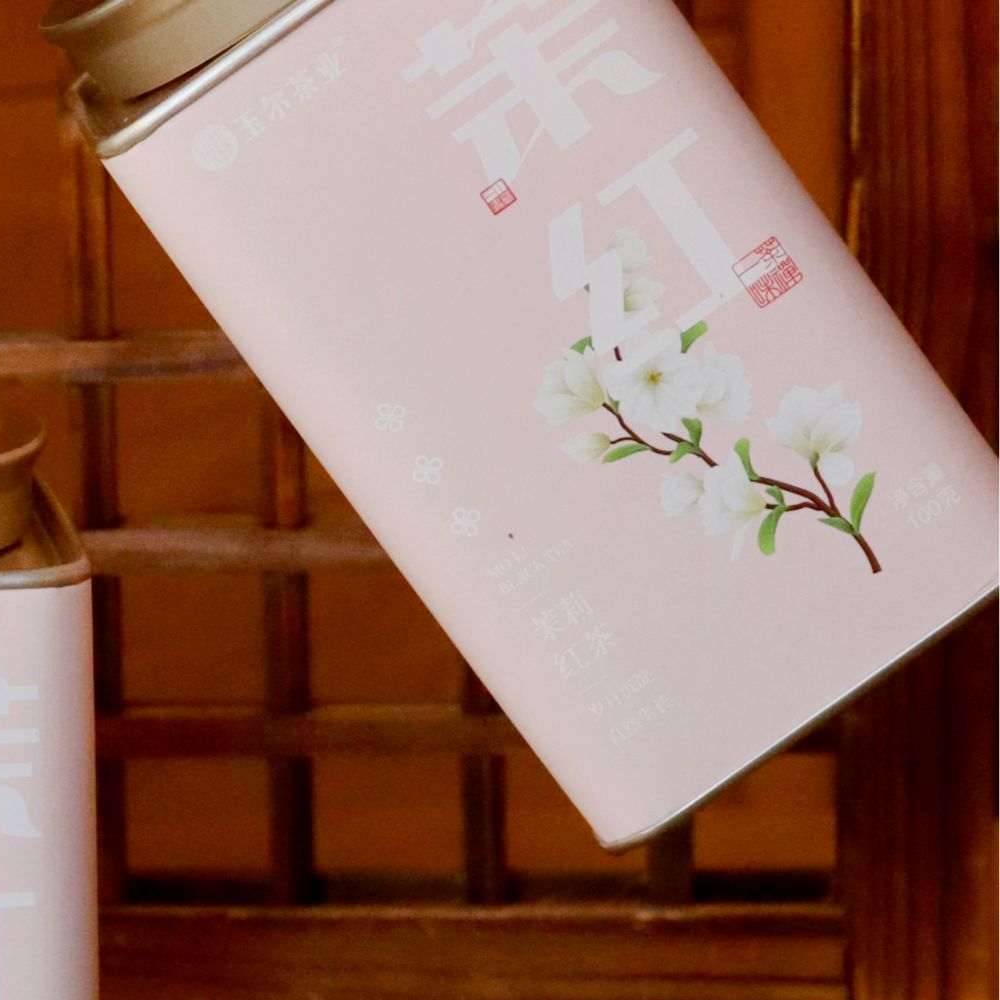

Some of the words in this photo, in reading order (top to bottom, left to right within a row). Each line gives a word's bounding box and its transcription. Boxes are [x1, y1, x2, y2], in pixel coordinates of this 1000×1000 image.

[233, 51, 348, 144] 玉尔茶业
[906, 484, 962, 529] 100克
[497, 559, 546, 596] BLACK
[529, 588, 594, 648] 茉莉
[552, 621, 617, 681] 红茶
